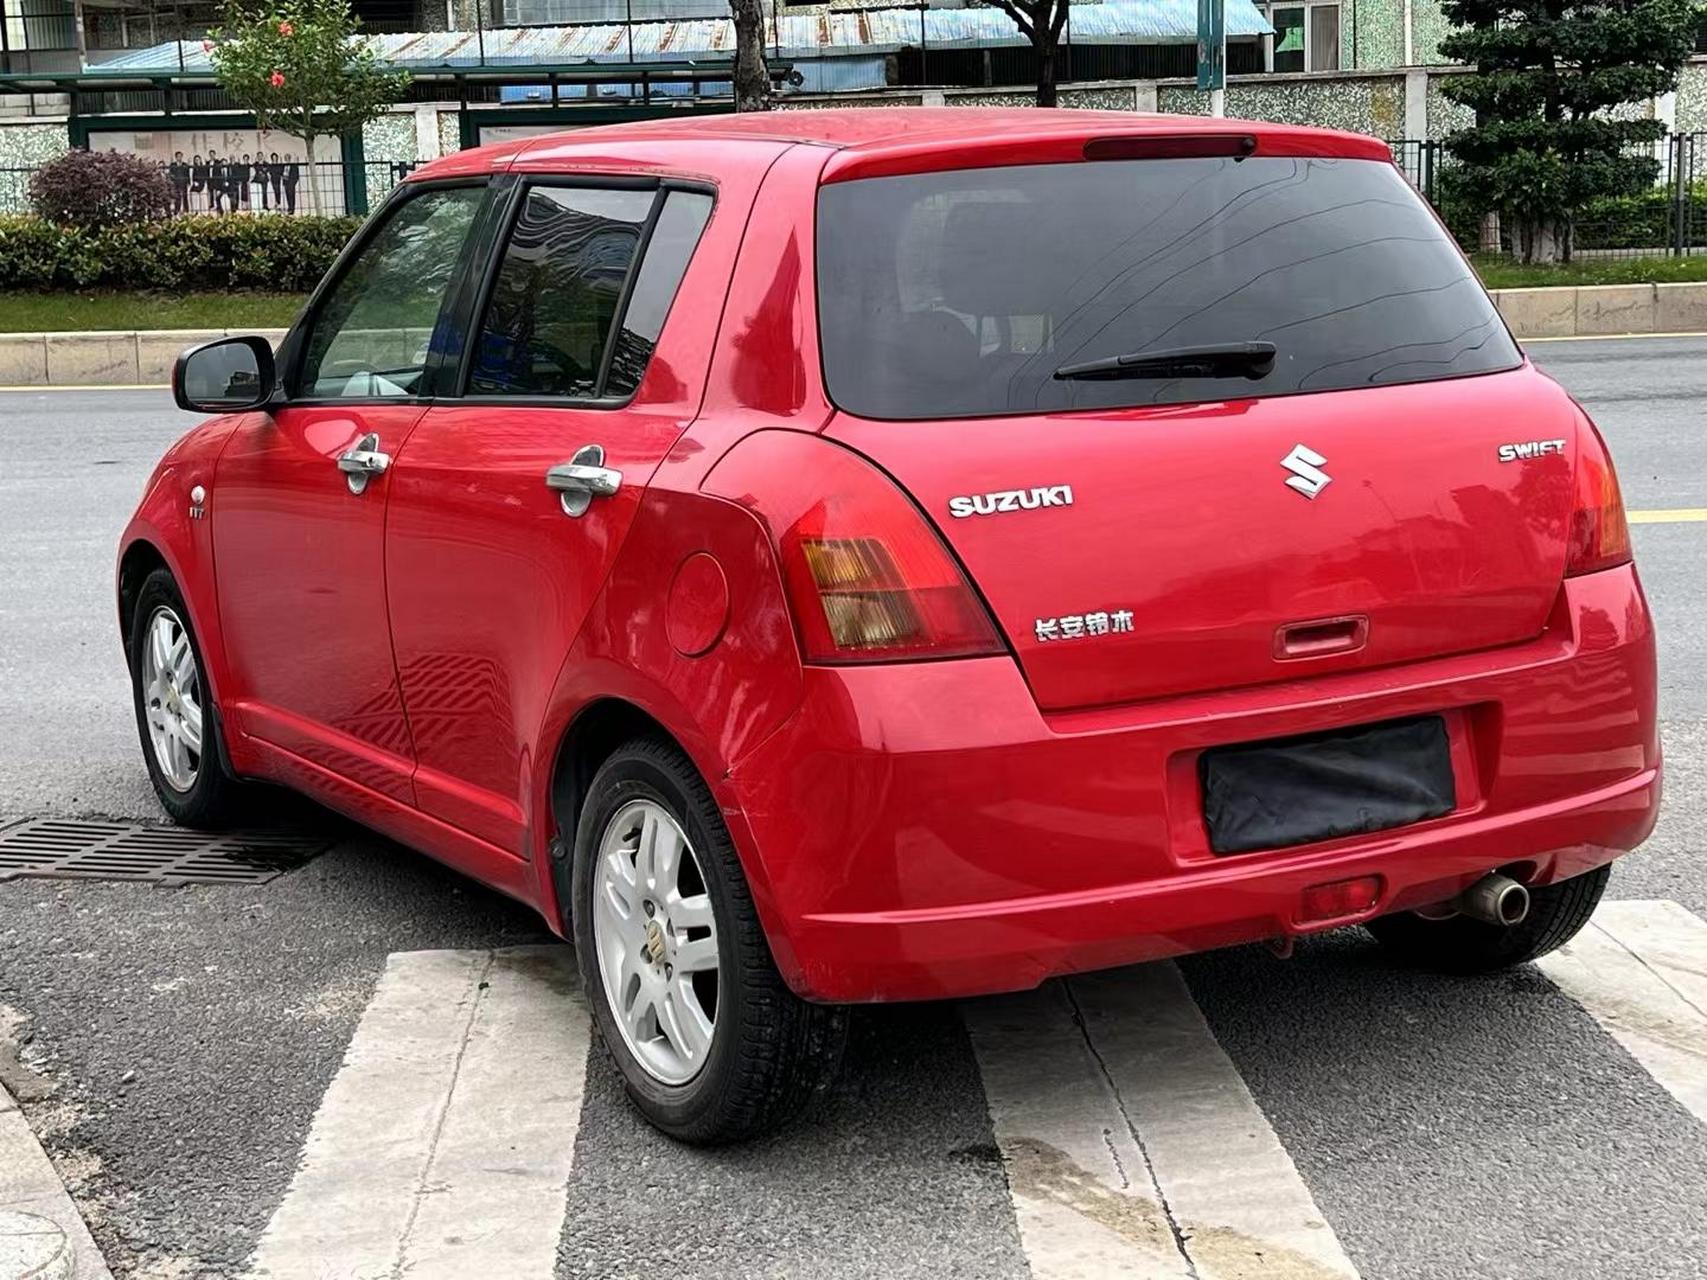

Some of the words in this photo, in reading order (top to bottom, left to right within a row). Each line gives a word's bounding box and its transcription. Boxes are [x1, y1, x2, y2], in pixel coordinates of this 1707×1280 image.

[1498, 439, 1567, 462] SWIFT
[949, 485, 1074, 518] SUZUKI
[1035, 610, 1134, 642] 长安铃木
